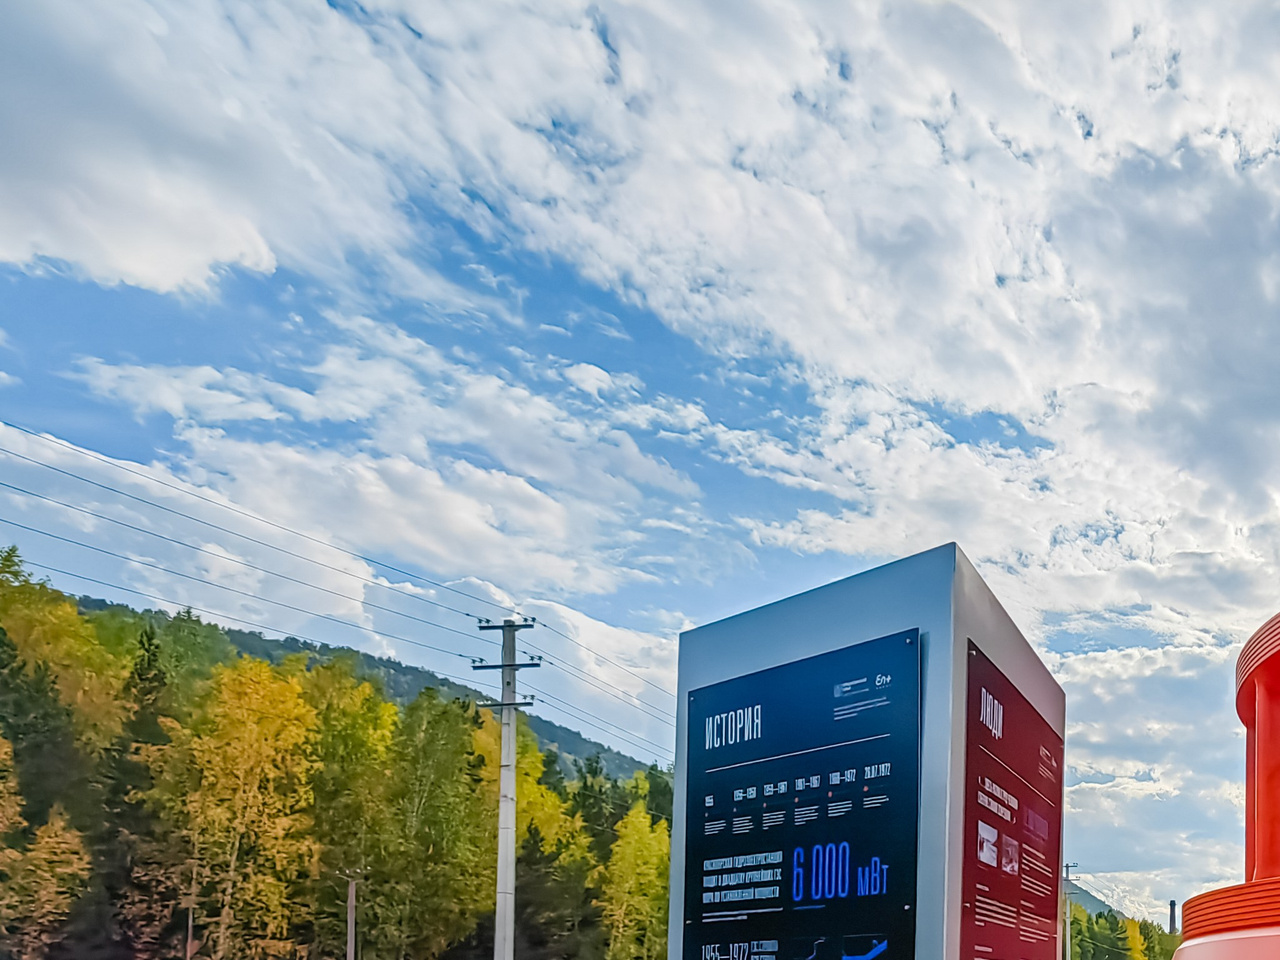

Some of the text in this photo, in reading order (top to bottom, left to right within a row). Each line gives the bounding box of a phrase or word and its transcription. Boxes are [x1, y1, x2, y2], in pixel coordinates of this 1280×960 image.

[704, 704, 762, 751] ИСТОРИЯ
[979, 686, 1004, 741] ЛЮДИ
[792, 847, 804, 901] 6
[811, 840, 850, 900] 000
